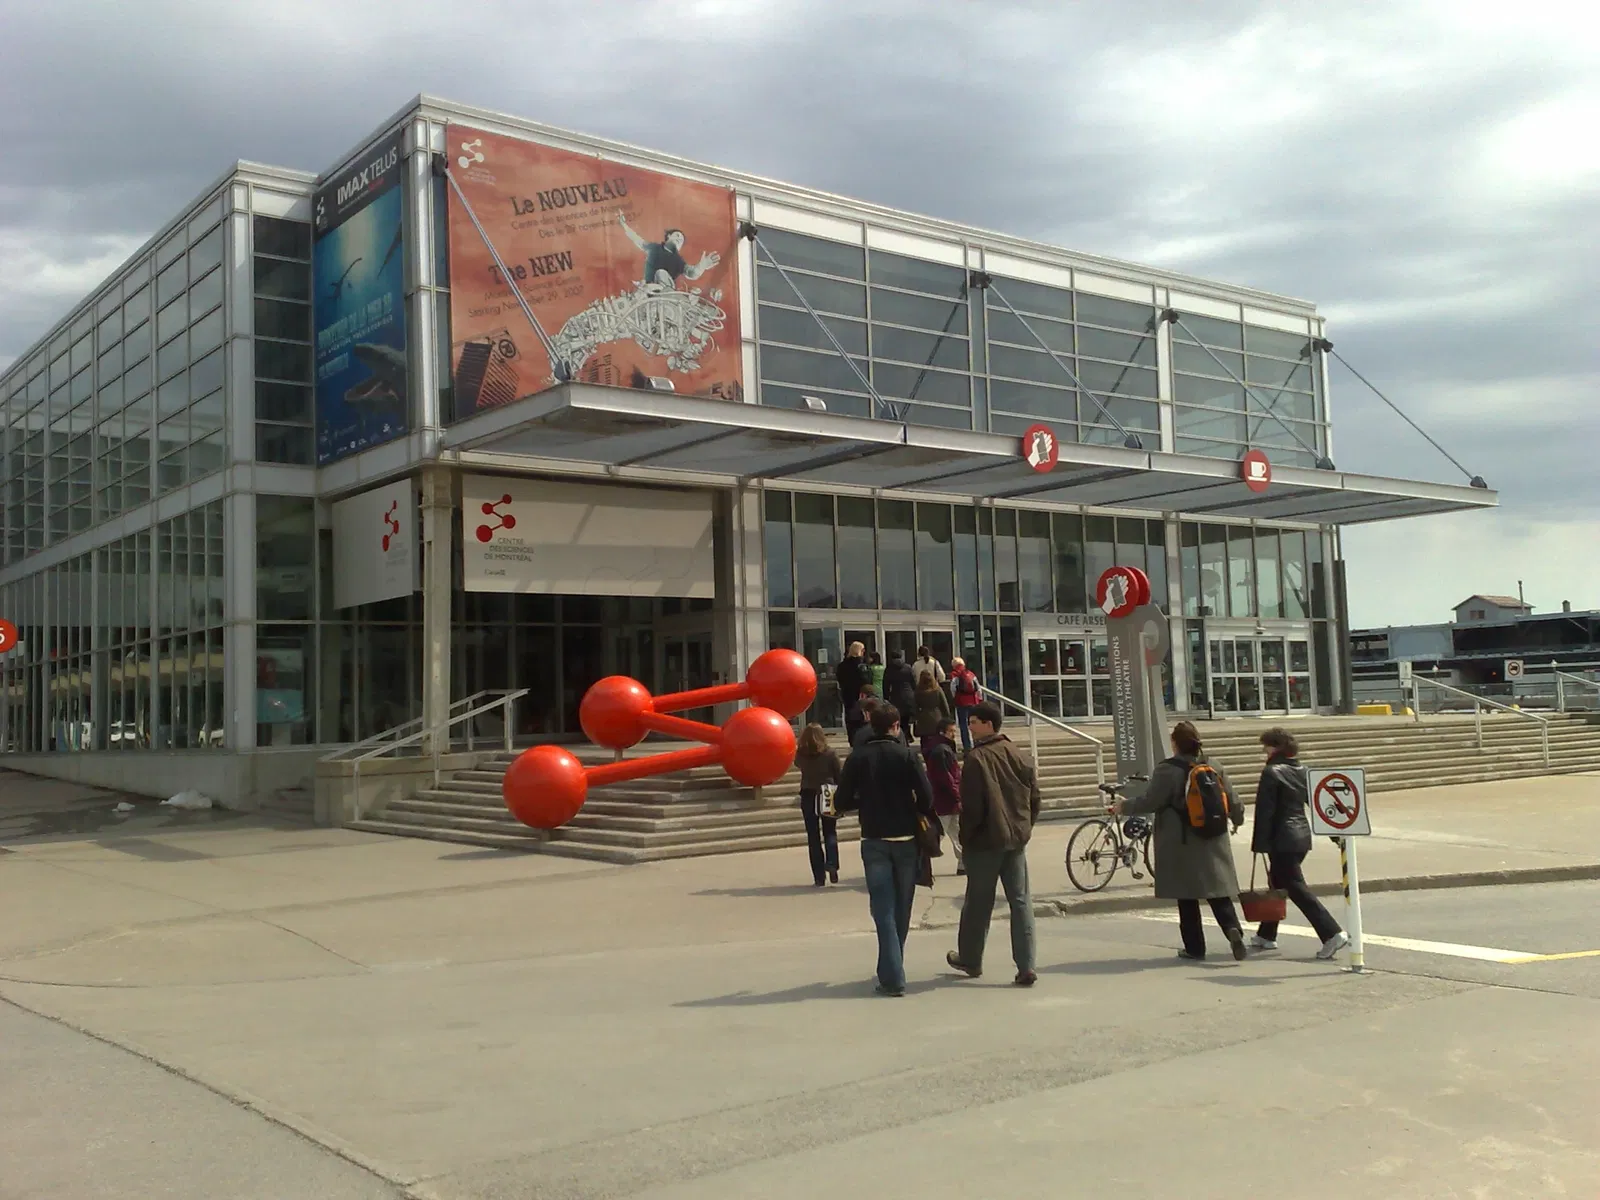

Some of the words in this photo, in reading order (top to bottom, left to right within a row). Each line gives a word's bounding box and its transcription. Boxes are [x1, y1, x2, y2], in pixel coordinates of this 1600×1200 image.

[337, 167, 369, 205] IMAX
[370, 146, 397, 180] TELUS
[510, 196, 535, 216] Le
[536, 178, 629, 212] NOUVEAU
[528, 251, 573, 278] NEW
[1113, 635, 1123, 697] EXHIBITIONS
[1123, 659, 1132, 701] THEATRE
[1117, 699, 1128, 761] INTERACTIVE
[1126, 702, 1134, 731] TELUS
[1129, 735, 1137, 761] IMAX
